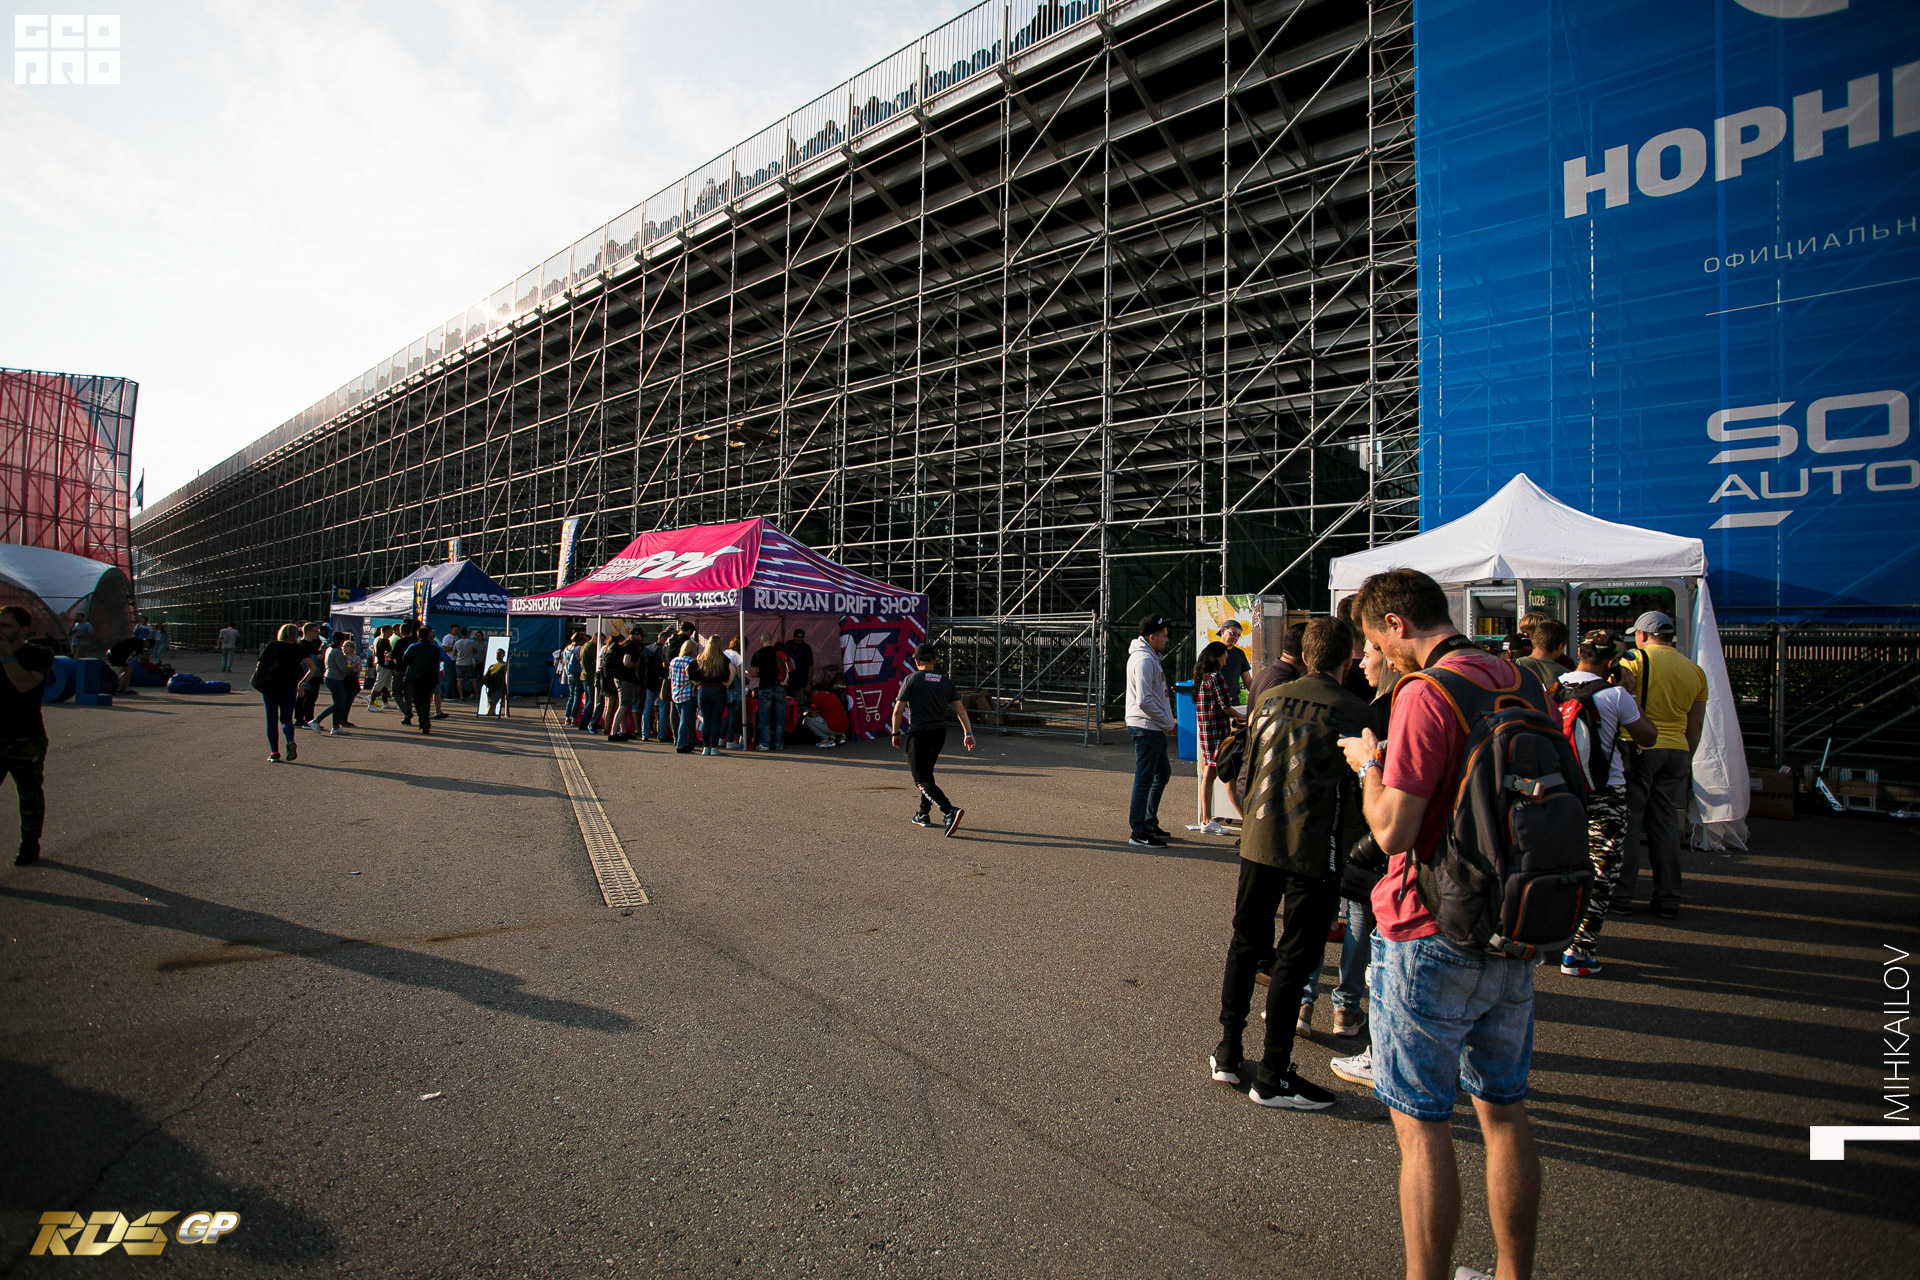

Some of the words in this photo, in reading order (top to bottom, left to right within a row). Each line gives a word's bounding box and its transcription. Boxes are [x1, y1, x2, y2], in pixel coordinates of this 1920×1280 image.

[512, 597, 562, 612] RDS-SHOP.RU
[661, 593, 694, 607] СТИЛЬ
[695, 591, 728, 608] ЗДЕСЬ
[754, 588, 829, 612] RUSSIAN
[835, 593, 876, 614] DRIFT
[880, 596, 920, 615] SHOP
[1528, 590, 1546, 607] fuze
[1589, 591, 1631, 607] fuze
